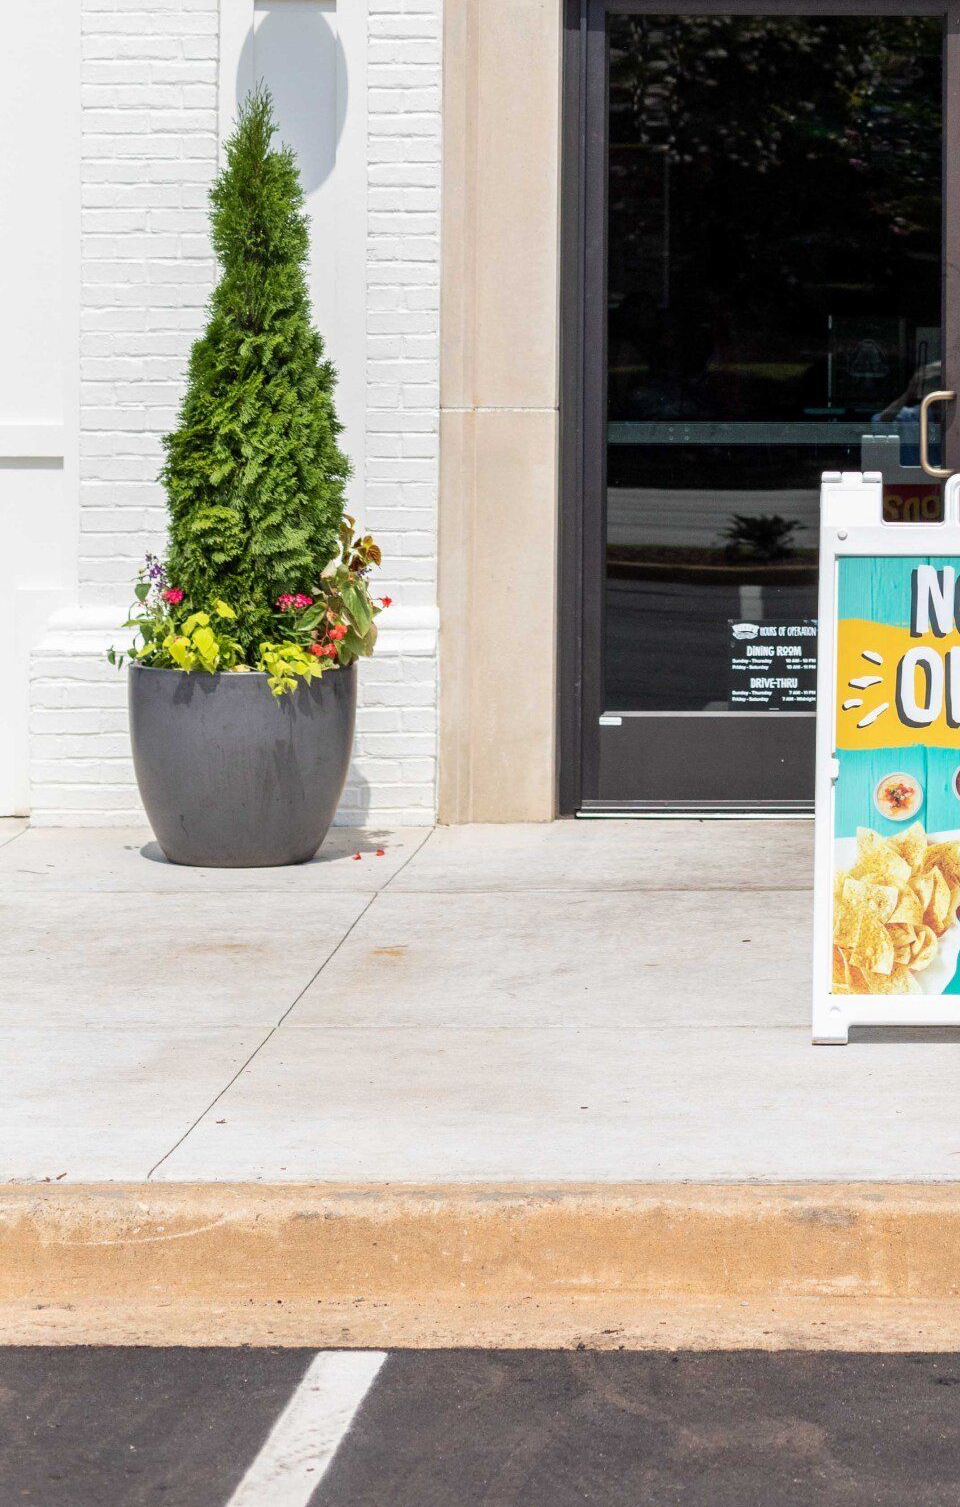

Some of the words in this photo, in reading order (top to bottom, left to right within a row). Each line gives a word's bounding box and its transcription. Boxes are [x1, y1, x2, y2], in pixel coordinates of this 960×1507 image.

[760, 626, 777, 637] HOURS
[778, 626, 786, 637] OF
[776, 645, 802, 656] ROOM
